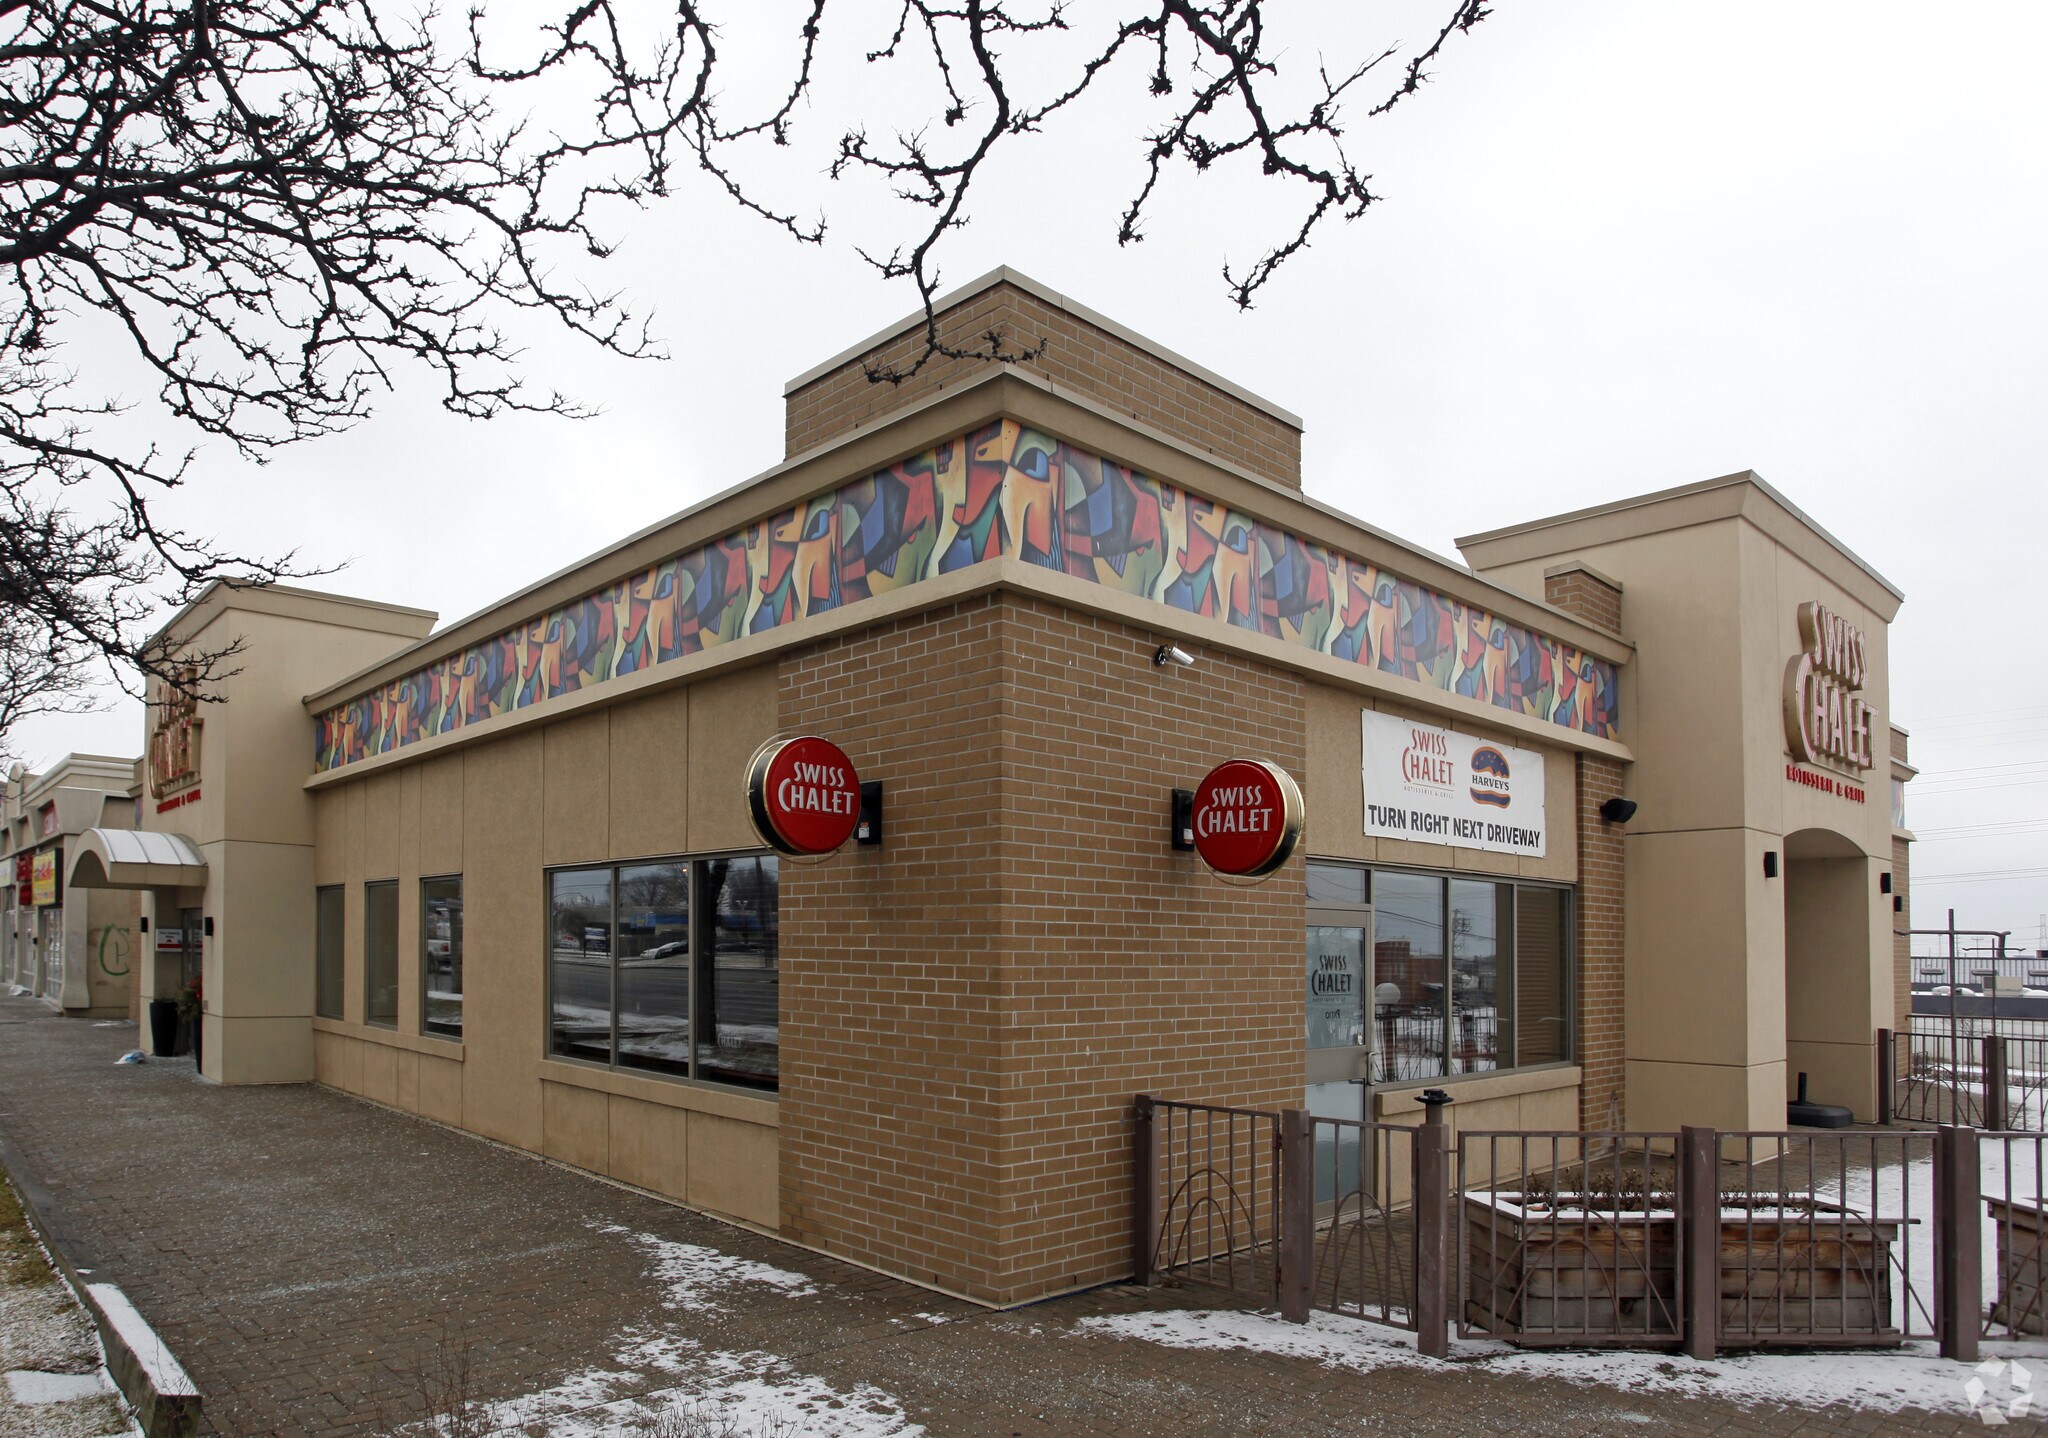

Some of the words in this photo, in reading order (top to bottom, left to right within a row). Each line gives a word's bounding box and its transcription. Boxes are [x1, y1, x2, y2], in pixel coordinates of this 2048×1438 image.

[1798, 600, 1867, 690] SWISS
[1784, 652, 1878, 770] CHALET
[1411, 728, 1447, 756] SWISS
[793, 761, 845, 788] SWISS
[1402, 746, 1454, 786] CHALET
[778, 777, 855, 815] CHALET
[1211, 785, 1262, 808] SWISS
[1472, 774, 1510, 791] HARVEY'S
[1197, 805, 1273, 838] CHALET
[1368, 804, 1407, 830] TURN
[1410, 811, 1449, 835] RIGHT
[1453, 817, 1484, 840] NEXT
[1487, 823, 1541, 848] DRIVEWAY
[1319, 954, 1347, 971] SWISS
[1311, 969, 1352, 996] CHALET
